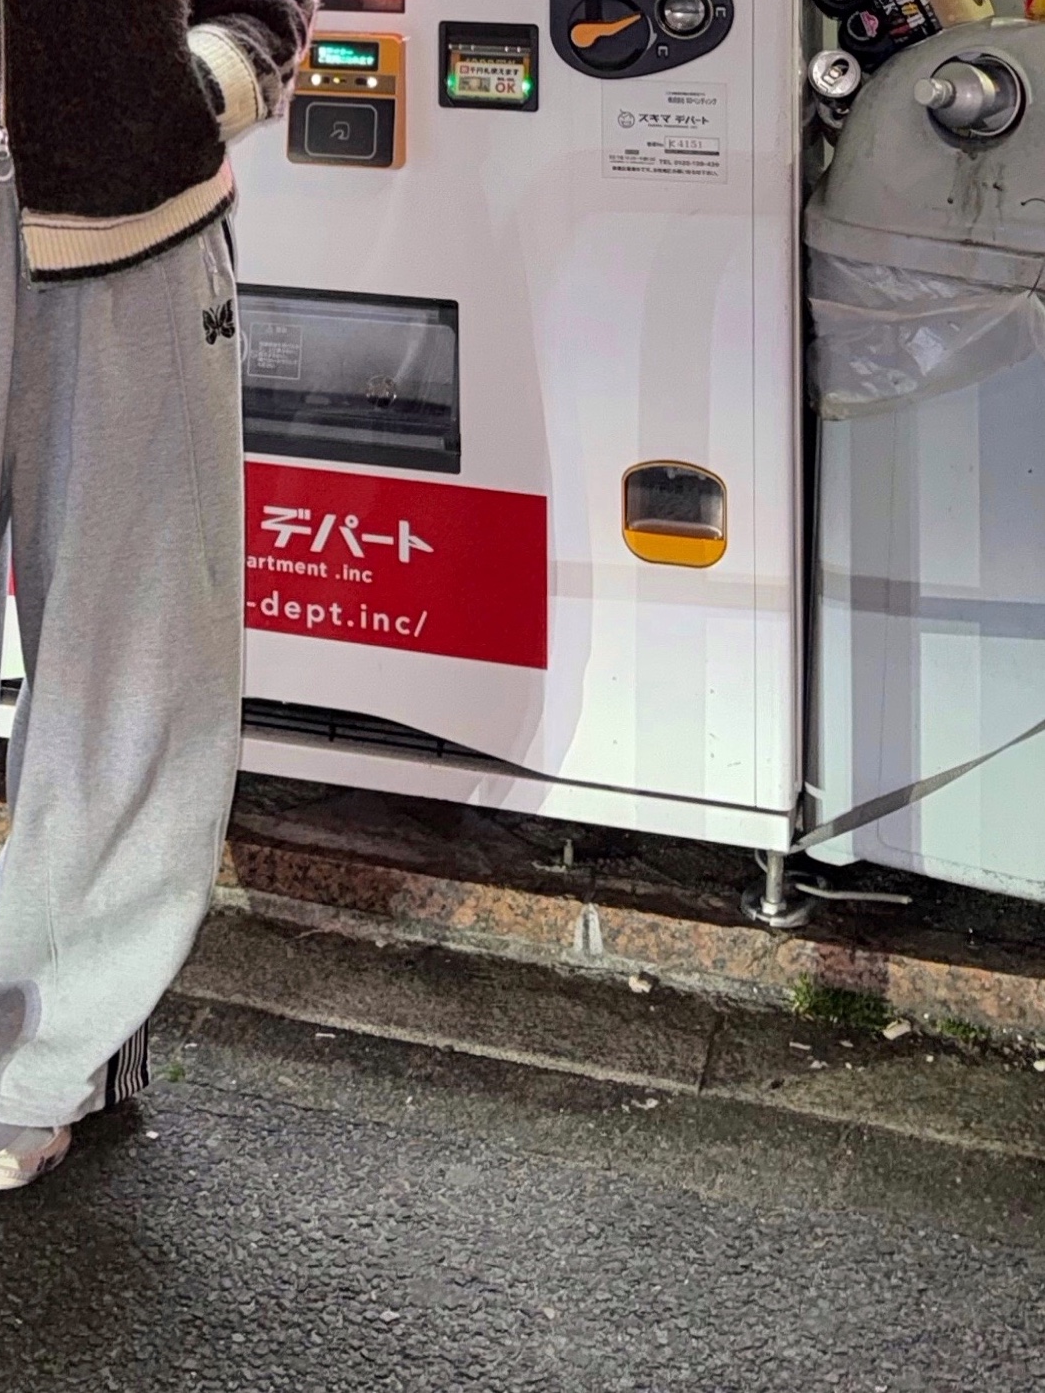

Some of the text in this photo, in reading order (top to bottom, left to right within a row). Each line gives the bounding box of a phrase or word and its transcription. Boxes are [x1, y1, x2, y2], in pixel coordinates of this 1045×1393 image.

[495, 82, 515, 94] OK
[639, 113, 709, 125] スキマ デパート
[261, 506, 434, 563] デパート
[247, 555, 373, 583] artment .inc
[246, 590, 428, 638] -dept.inc/
